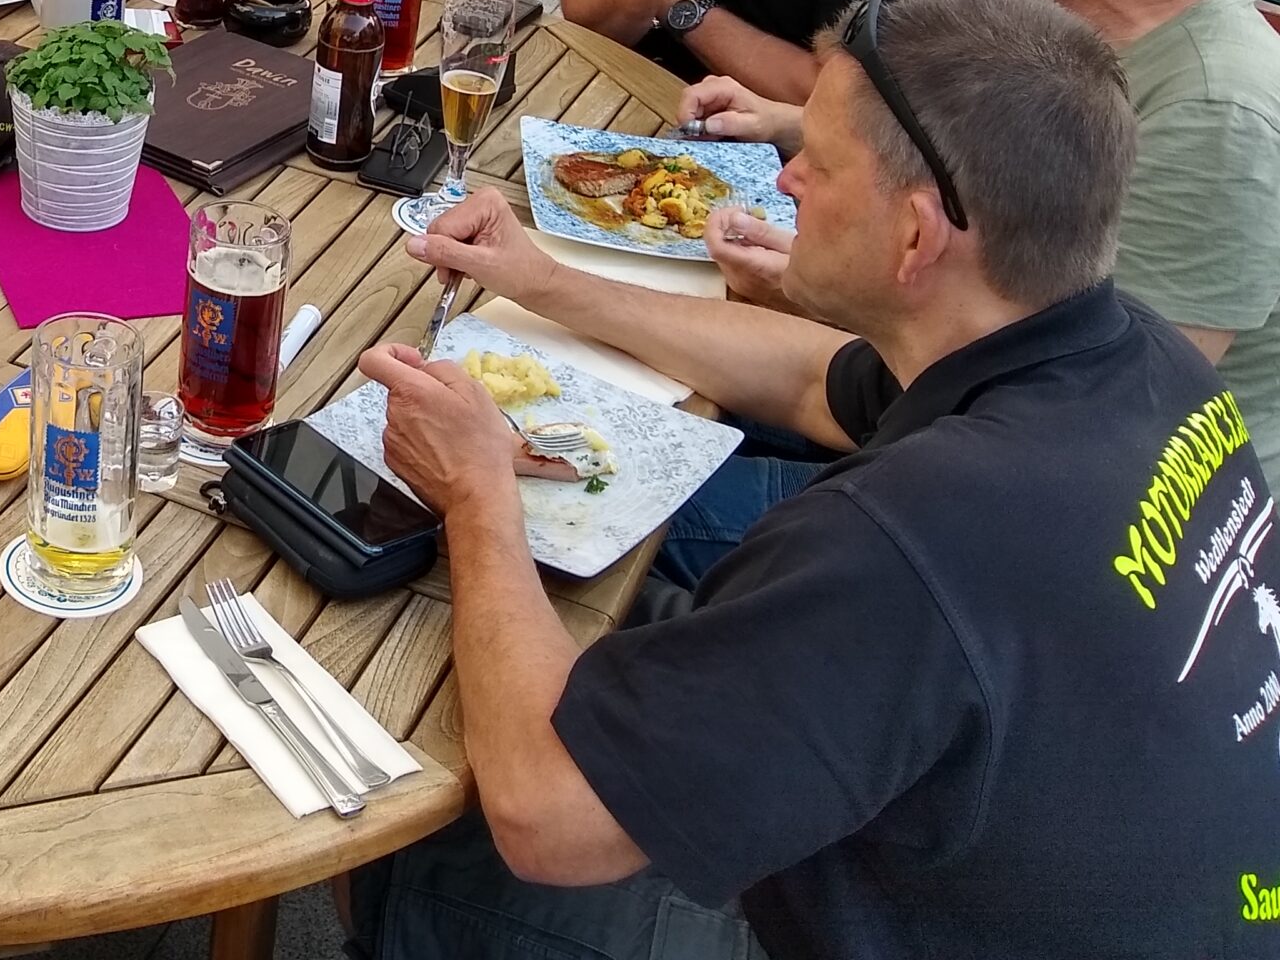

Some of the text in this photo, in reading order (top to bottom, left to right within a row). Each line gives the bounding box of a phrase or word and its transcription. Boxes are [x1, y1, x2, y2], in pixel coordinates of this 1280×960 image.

[43, 478, 97, 500] Augustiner
[60, 498, 97, 512] München
[1232, 701, 1265, 742] Anno
